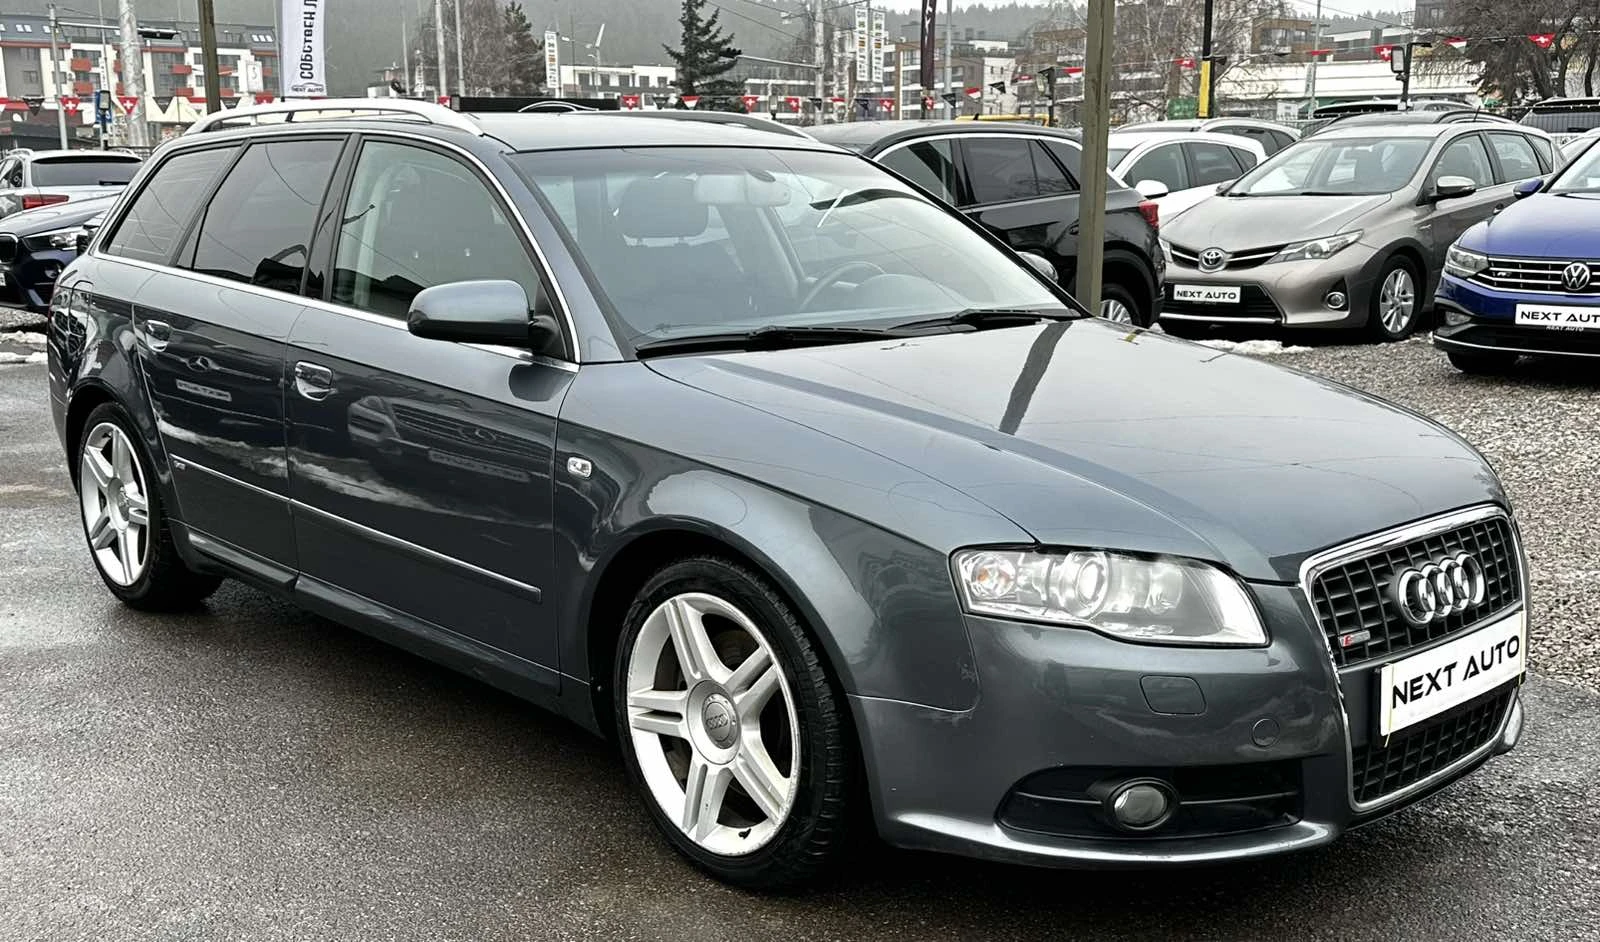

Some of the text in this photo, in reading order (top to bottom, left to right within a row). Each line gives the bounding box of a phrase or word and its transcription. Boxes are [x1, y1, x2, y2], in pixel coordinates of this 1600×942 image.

[300, 11, 316, 80] СОБСТВЕН
[1177, 290, 1237, 300] NEXT AUTO
[1520, 311, 1562, 321] NEXT
[1392, 635, 1520, 709] NEXT AUTO
